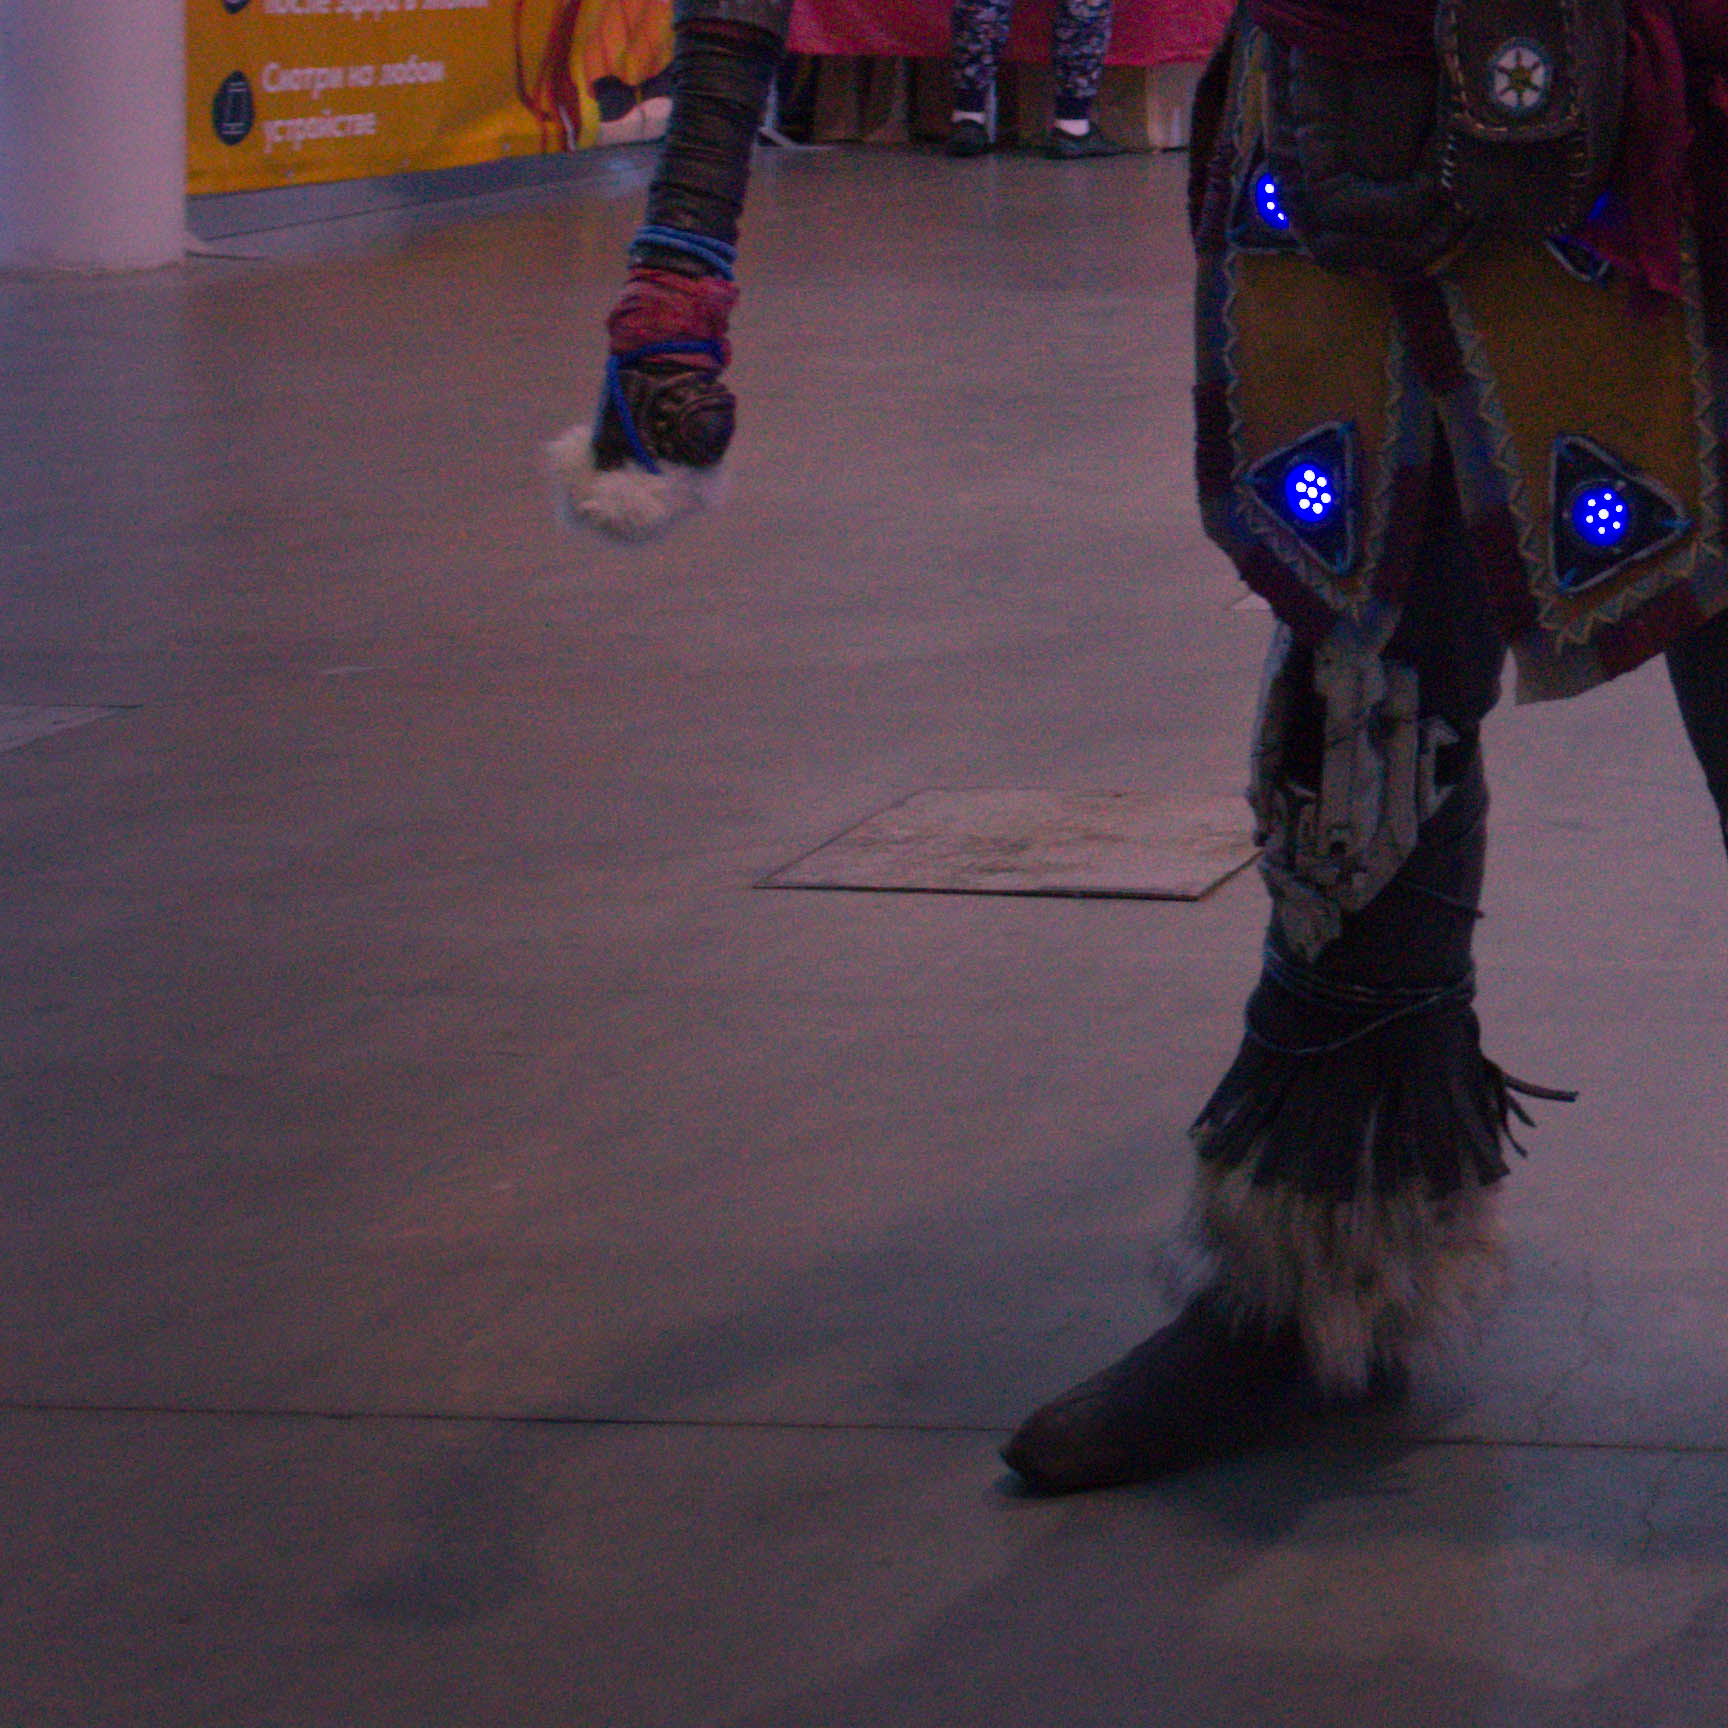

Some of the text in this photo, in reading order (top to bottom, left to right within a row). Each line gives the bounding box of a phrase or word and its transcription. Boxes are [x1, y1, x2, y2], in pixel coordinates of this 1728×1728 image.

[262, 62, 344, 100] Смотри
[349, 65, 374, 87] на
[263, 109, 376, 154] устройстве
